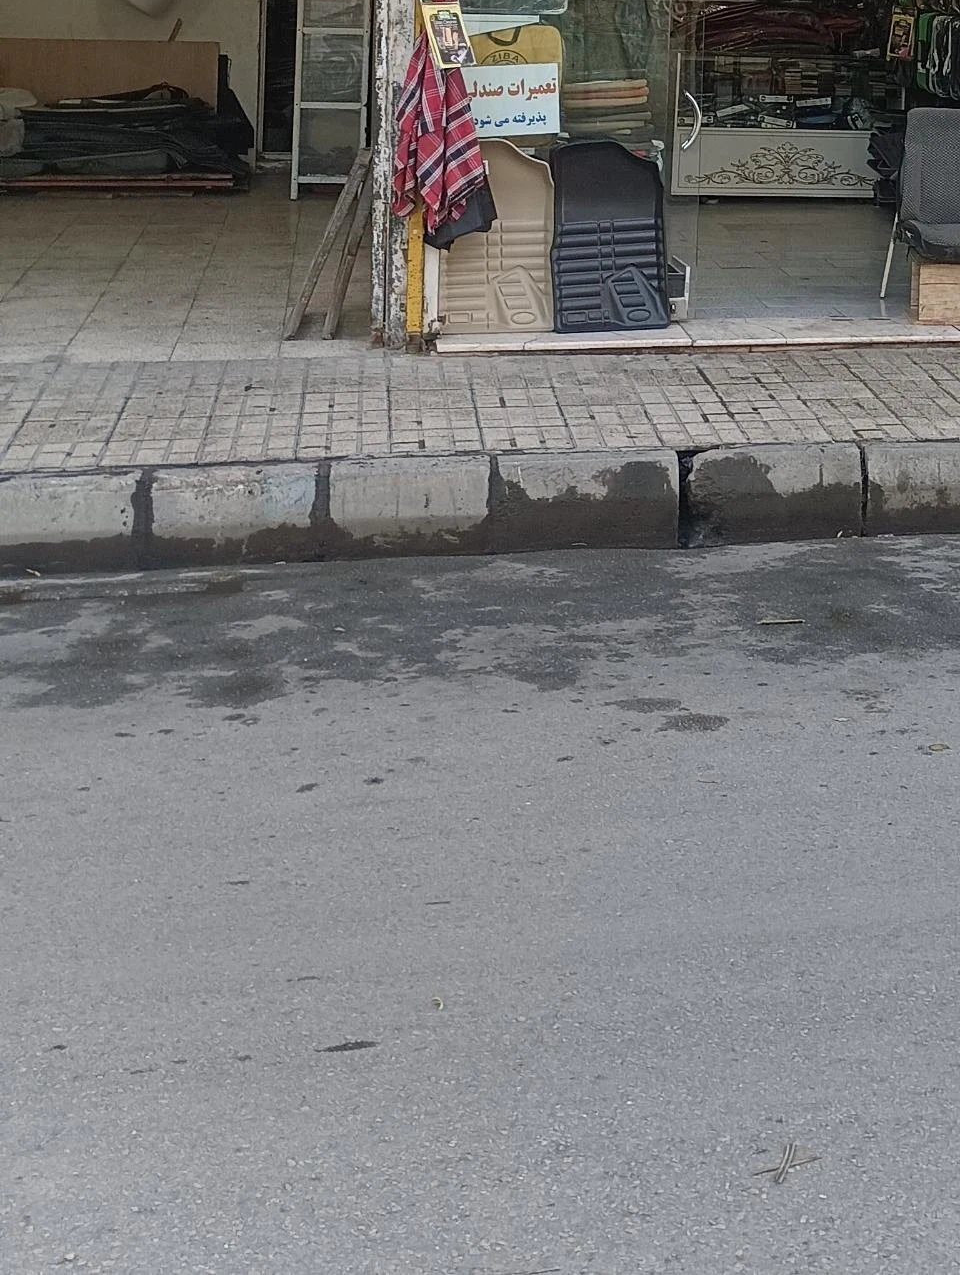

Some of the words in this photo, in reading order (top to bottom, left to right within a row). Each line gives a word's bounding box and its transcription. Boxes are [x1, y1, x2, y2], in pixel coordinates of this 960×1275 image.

[490, 52, 519, 64] ZIBA
[507, 77, 557, 101] تعمیرات
[494, 117, 510, 128] می
[512, 112, 547, 127] پذیرفته
